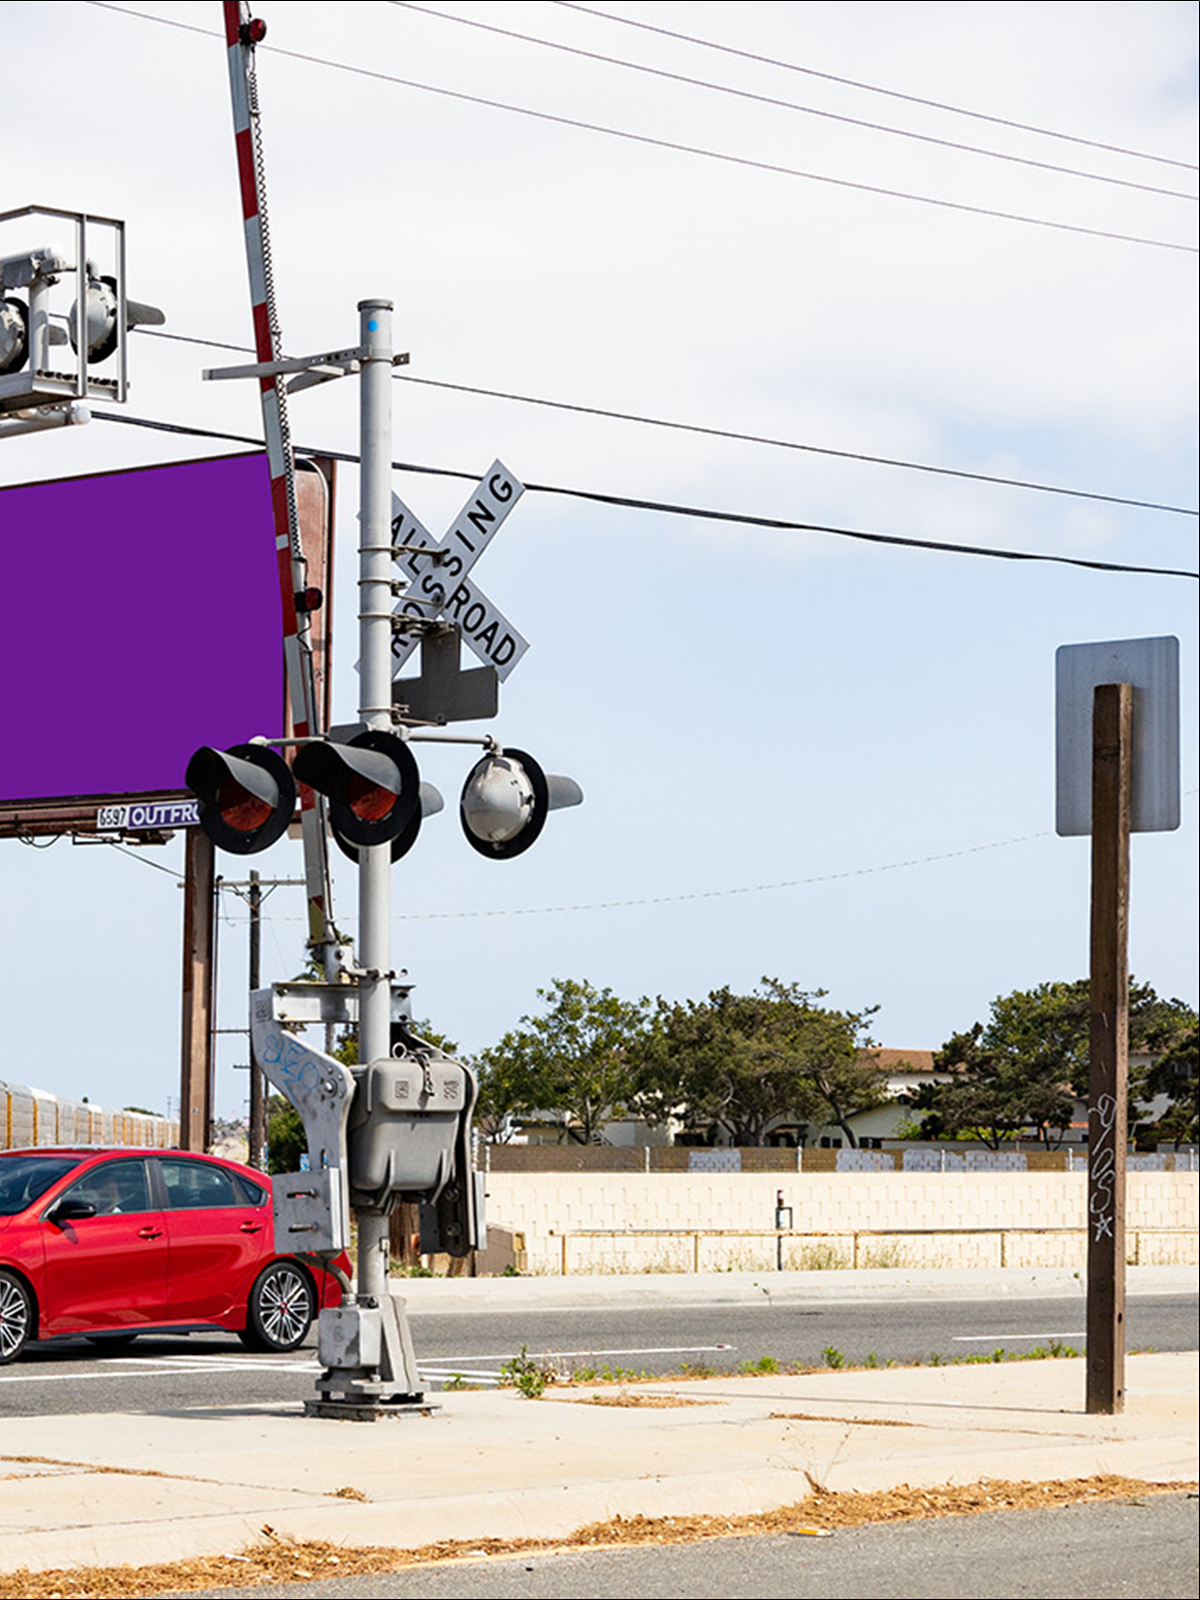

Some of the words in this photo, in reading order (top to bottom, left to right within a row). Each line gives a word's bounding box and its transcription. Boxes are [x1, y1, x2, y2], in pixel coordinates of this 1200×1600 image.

[391, 473, 513, 658] ROSSING
[391, 513, 427, 575] AIL
[445, 583, 516, 666] ROAD
[99, 806, 127, 826] 6597
